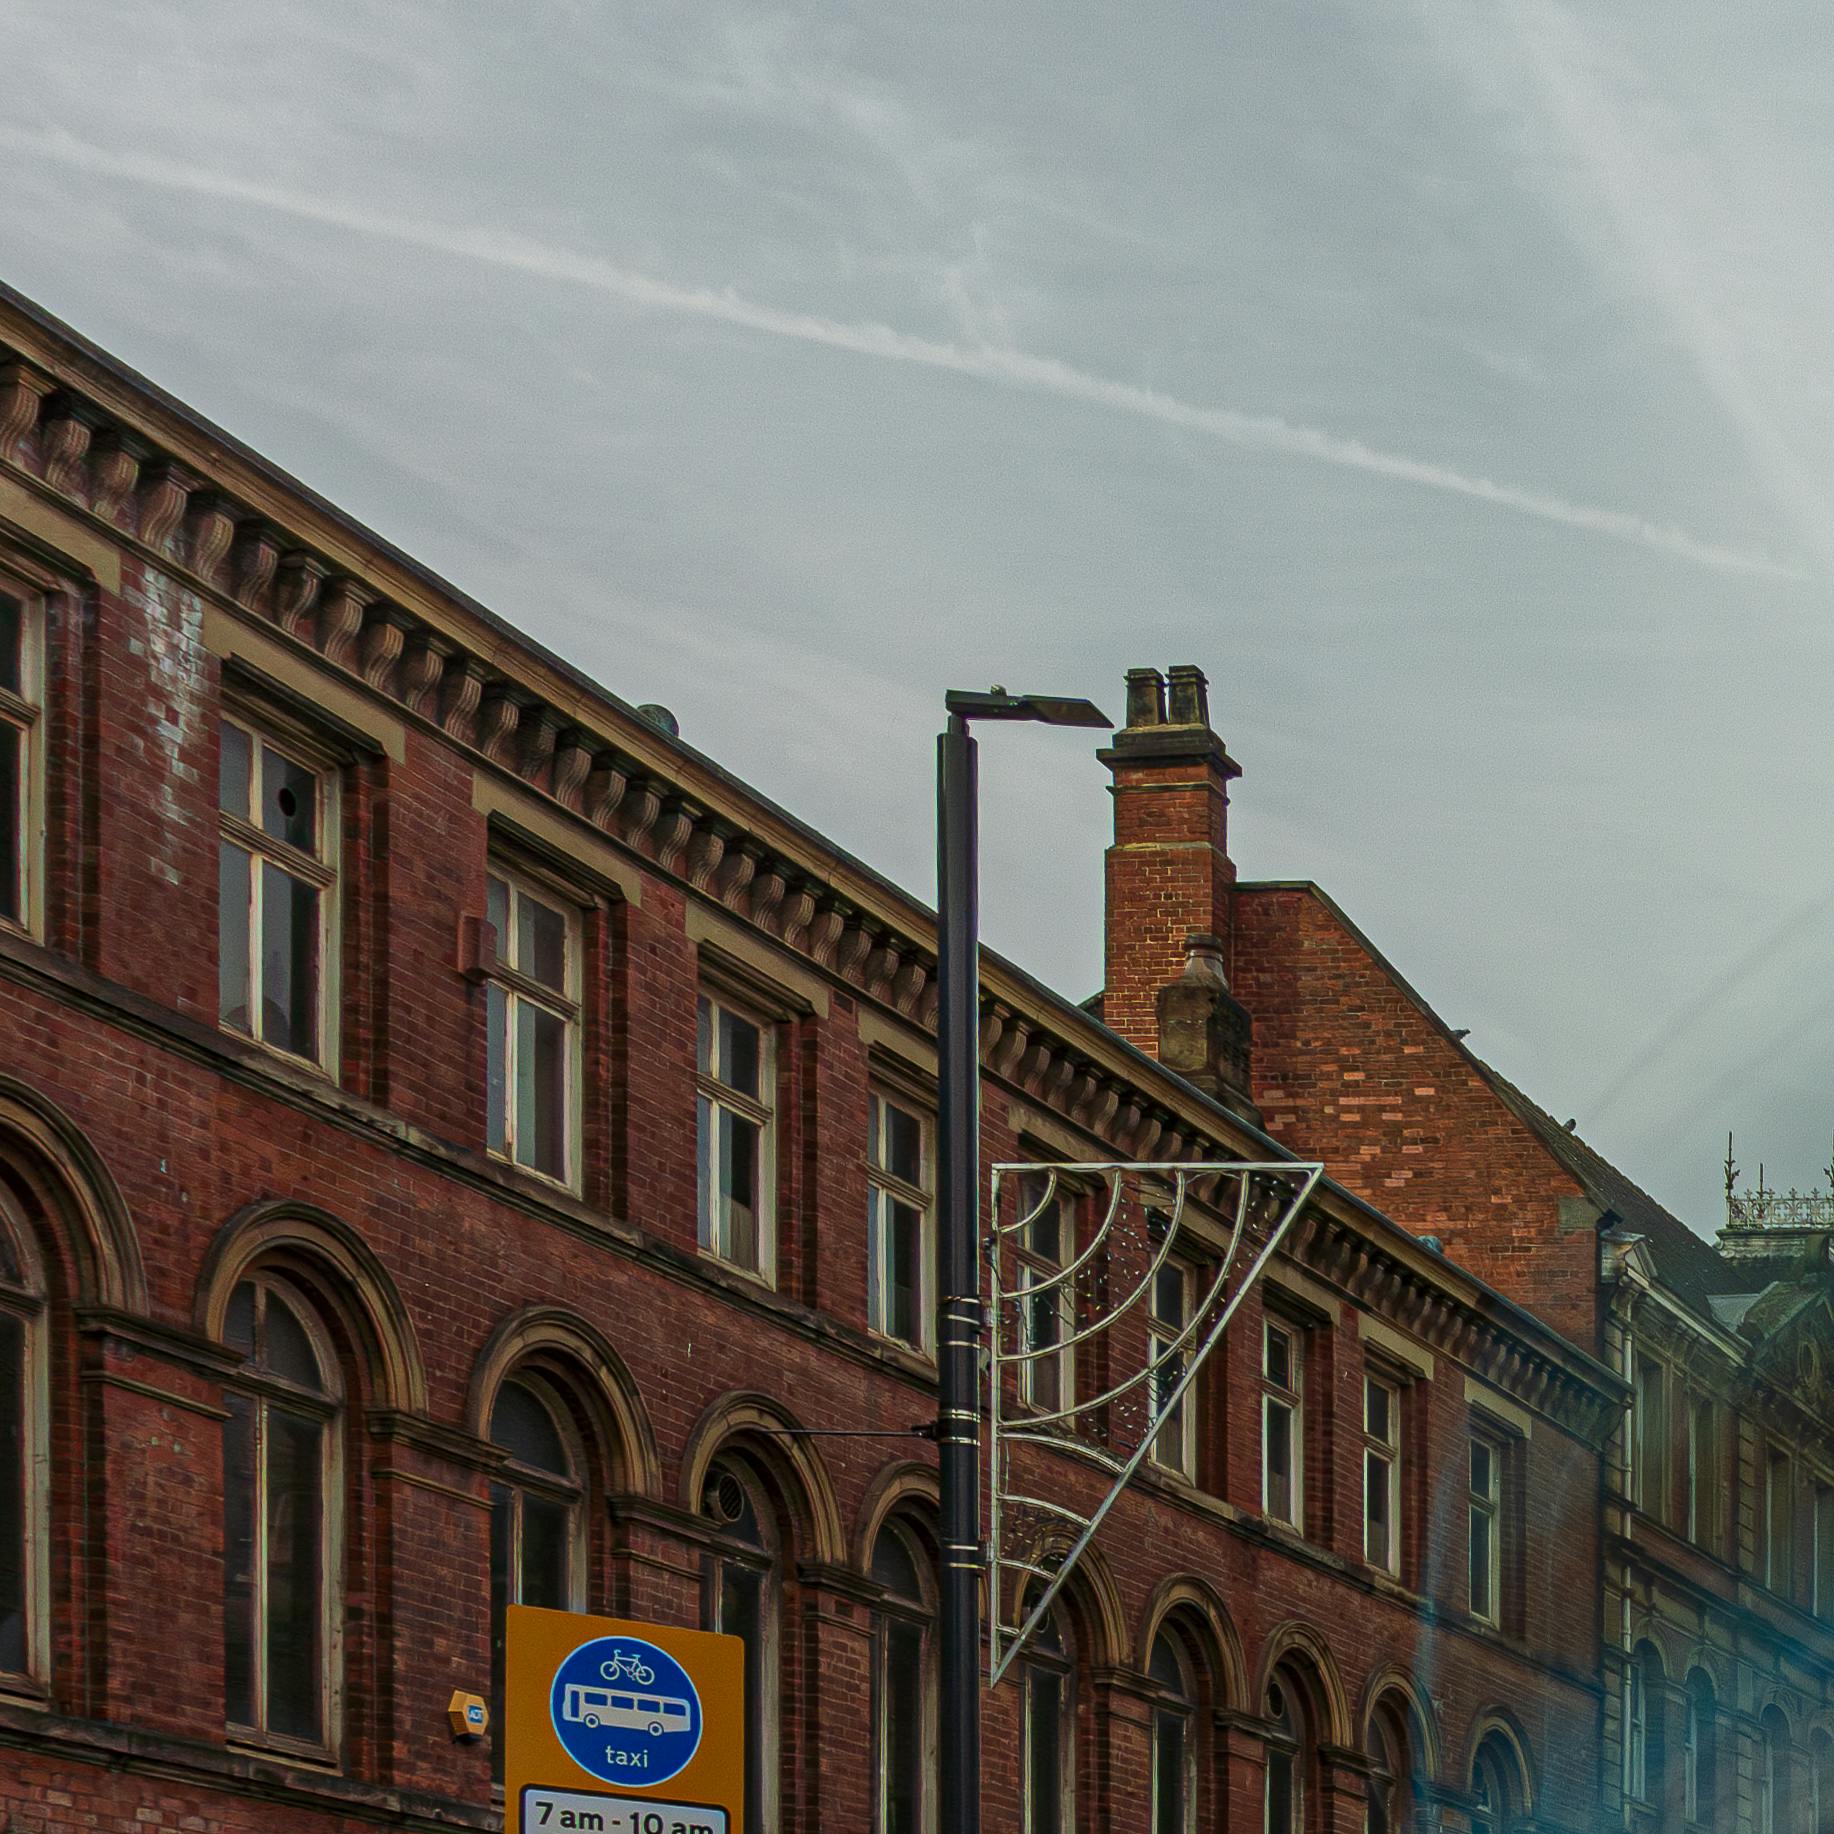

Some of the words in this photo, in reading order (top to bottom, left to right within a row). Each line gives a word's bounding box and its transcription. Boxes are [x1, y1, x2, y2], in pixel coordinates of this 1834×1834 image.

[605, 1745, 648, 1768] taxi
[535, 1802, 553, 1825] 7
[560, 1809, 604, 1831] am
